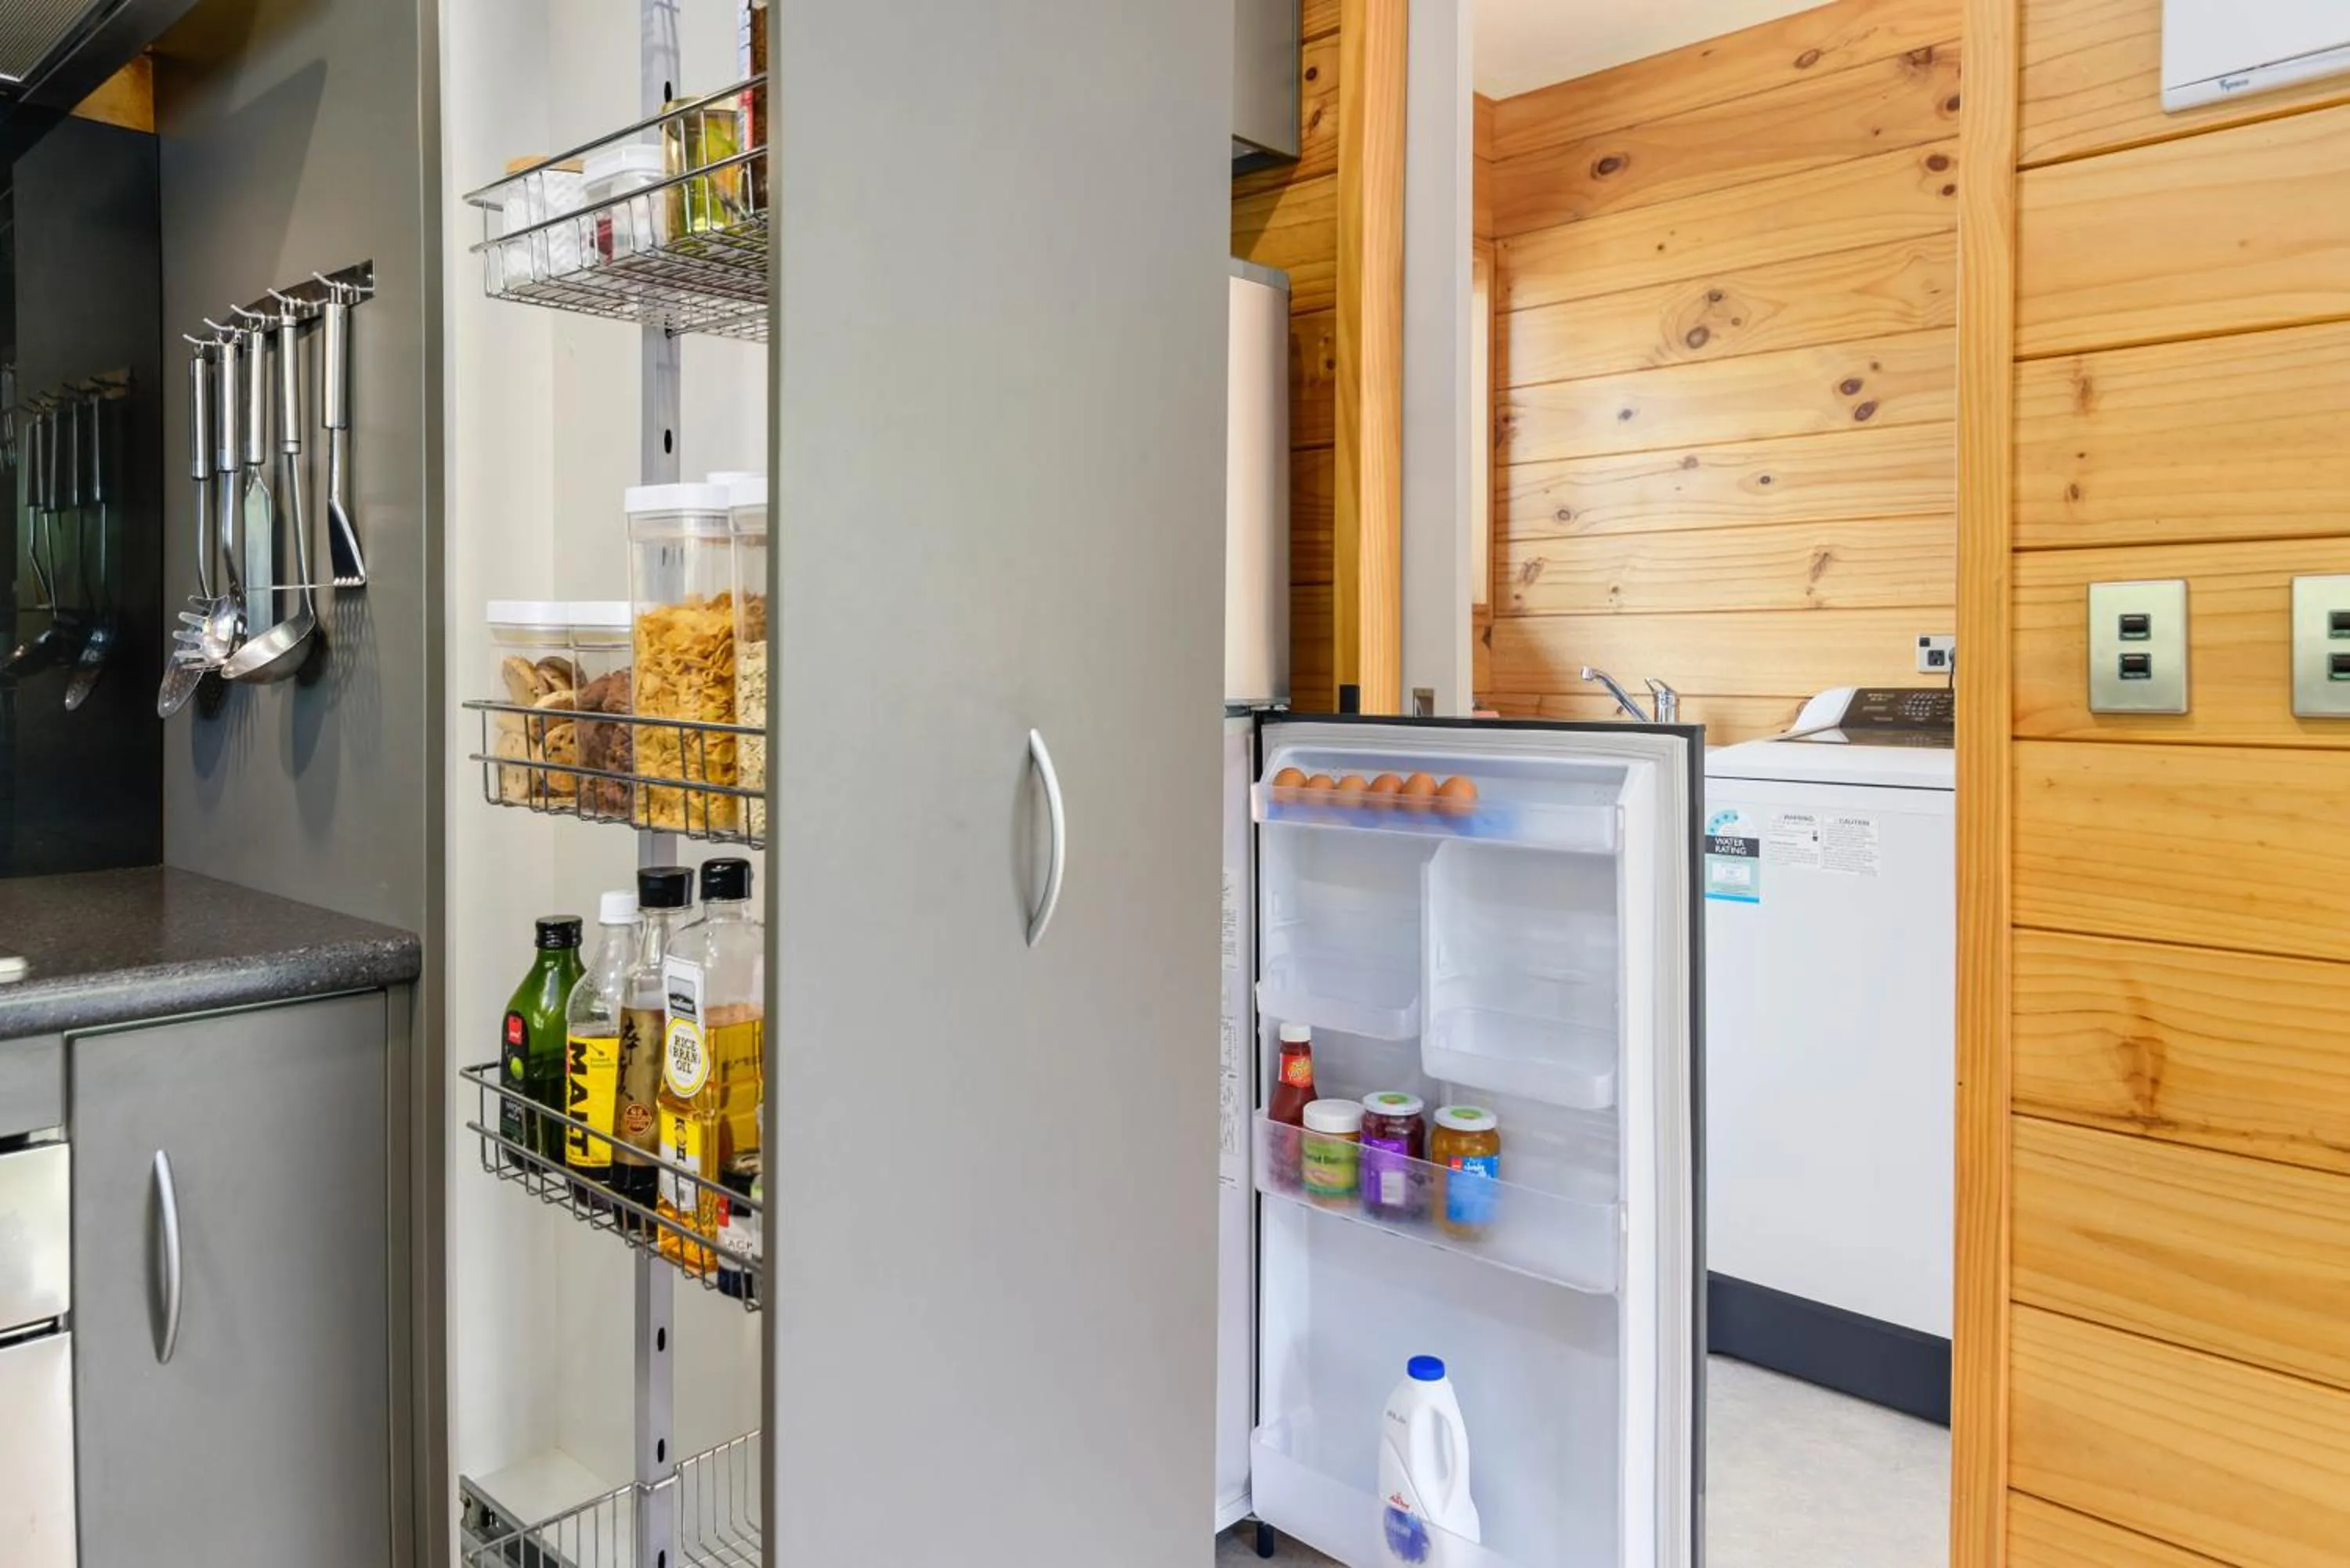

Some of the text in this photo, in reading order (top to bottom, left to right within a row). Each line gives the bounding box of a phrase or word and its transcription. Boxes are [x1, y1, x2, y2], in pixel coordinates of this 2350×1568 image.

[1715, 837, 1745, 847] WATER
[1715, 845, 1747, 854] RATING
[674, 1035, 696, 1051] RICE
[673, 1047, 697, 1064] BRAN
[676, 1060, 693, 1075] OIL
[569, 1040, 589, 1157] MALT
